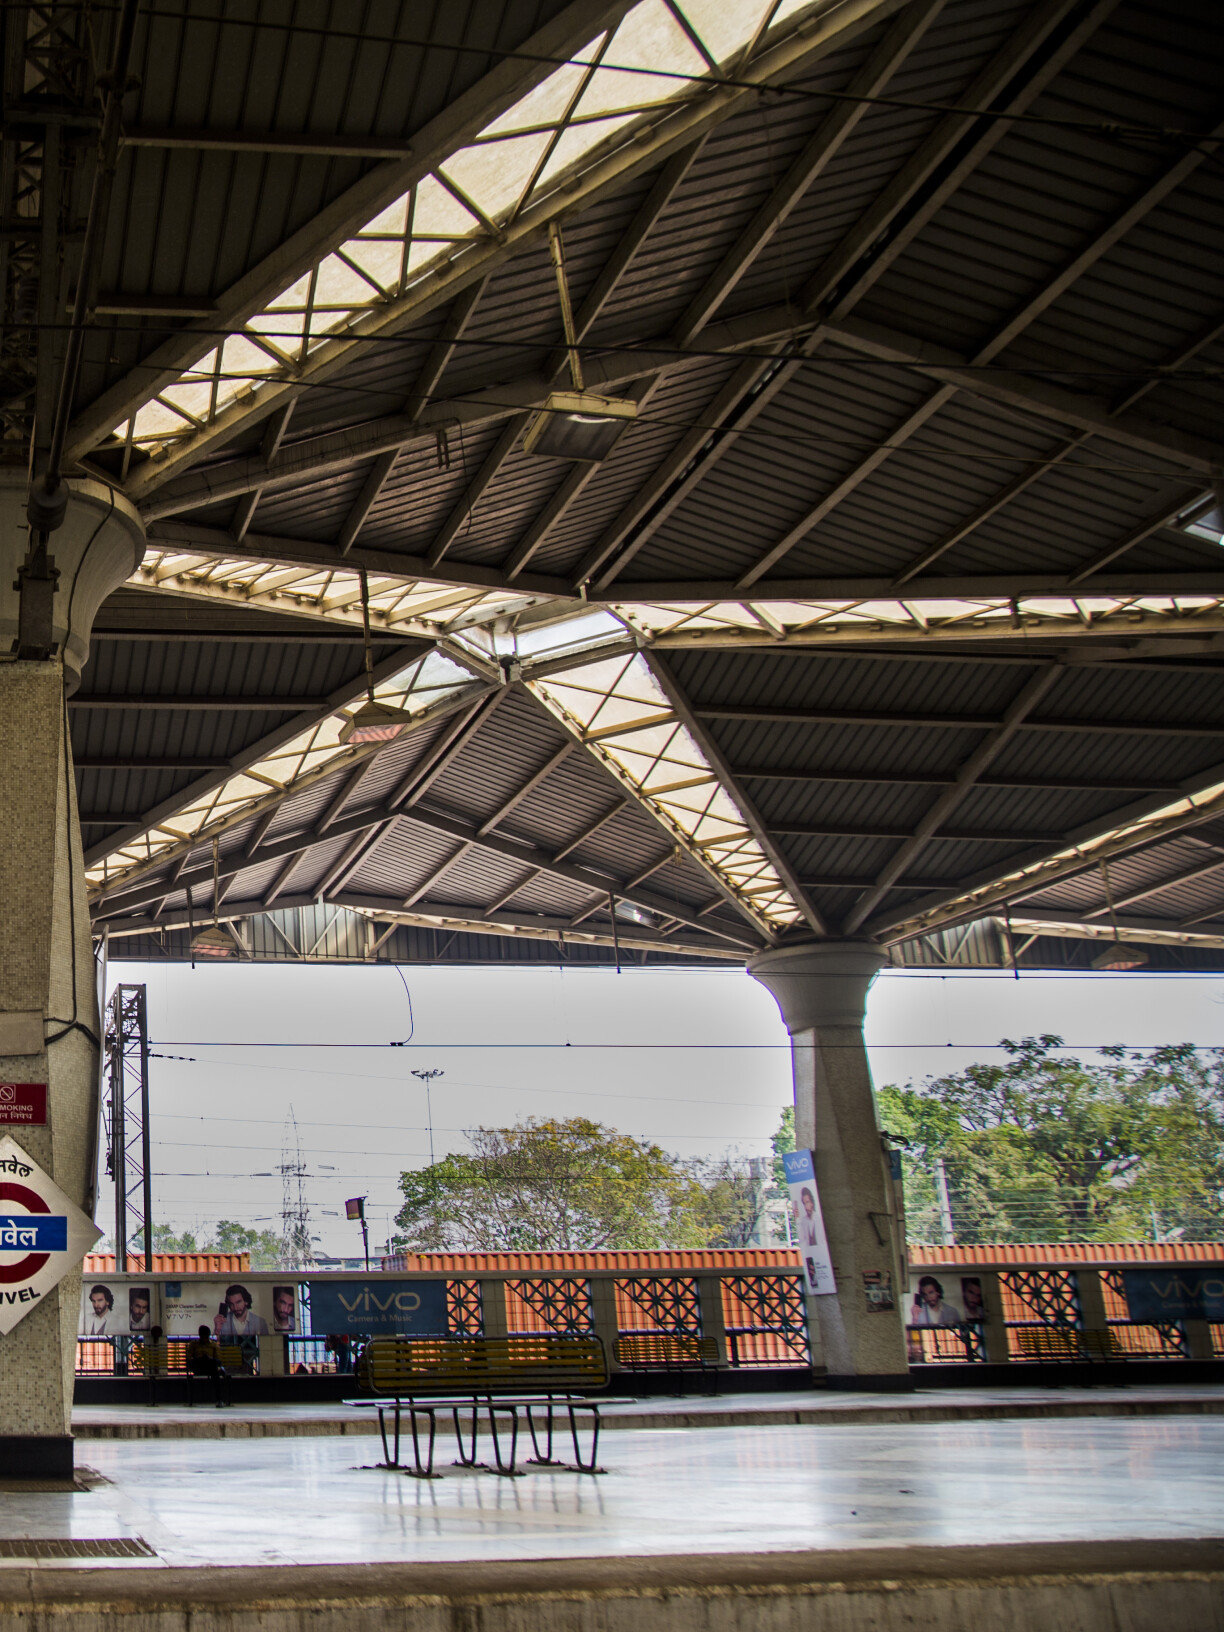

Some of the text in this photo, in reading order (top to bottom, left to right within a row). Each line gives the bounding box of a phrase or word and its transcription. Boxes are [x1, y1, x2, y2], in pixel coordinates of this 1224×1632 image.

[337, 1287, 421, 1312] vivo
[348, 1314, 413, 1322] Camera & Music
